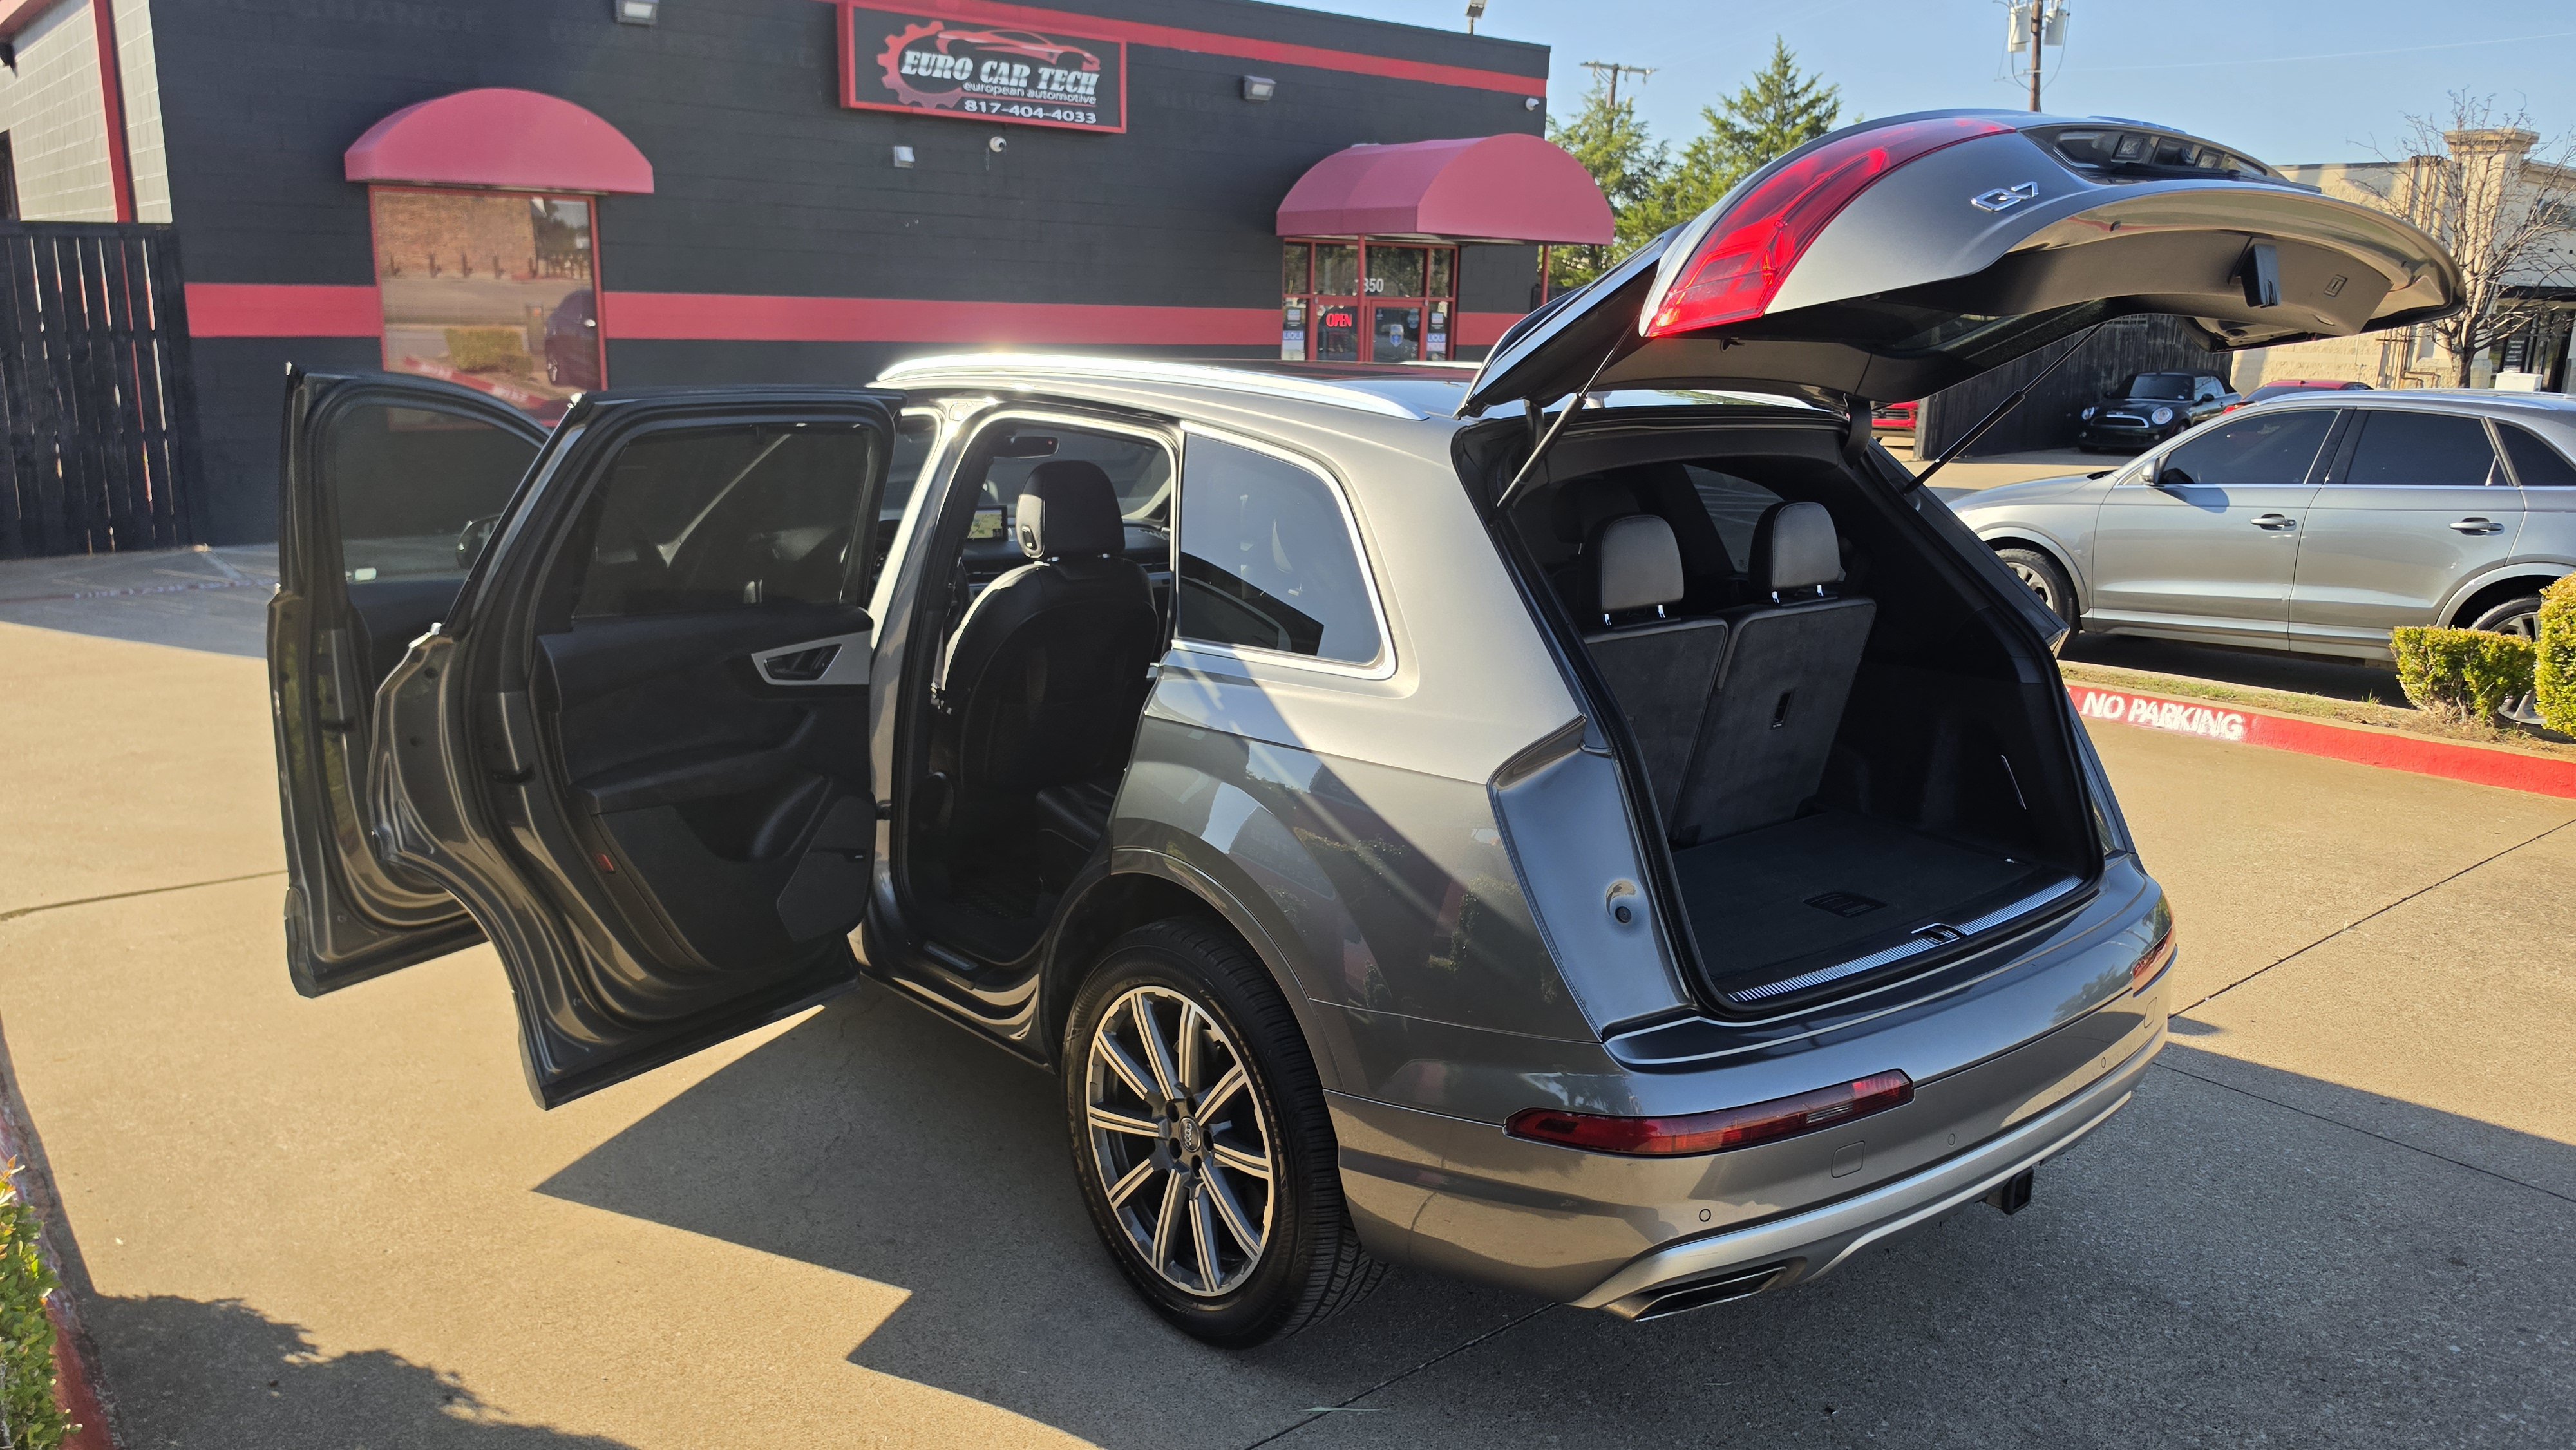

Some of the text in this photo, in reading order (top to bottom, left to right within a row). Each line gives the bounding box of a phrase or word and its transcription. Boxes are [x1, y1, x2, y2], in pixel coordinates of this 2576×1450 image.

[901, 50, 1100, 95] EURO CAR TECH
[963, 82, 1097, 104] european automotive
[964, 100, 1097, 124] 817-404-4033
[1971, 181, 2039, 211] Q7
[1326, 313, 1352, 327] OPEN
[2080, 691, 2245, 740] NO PARKING
